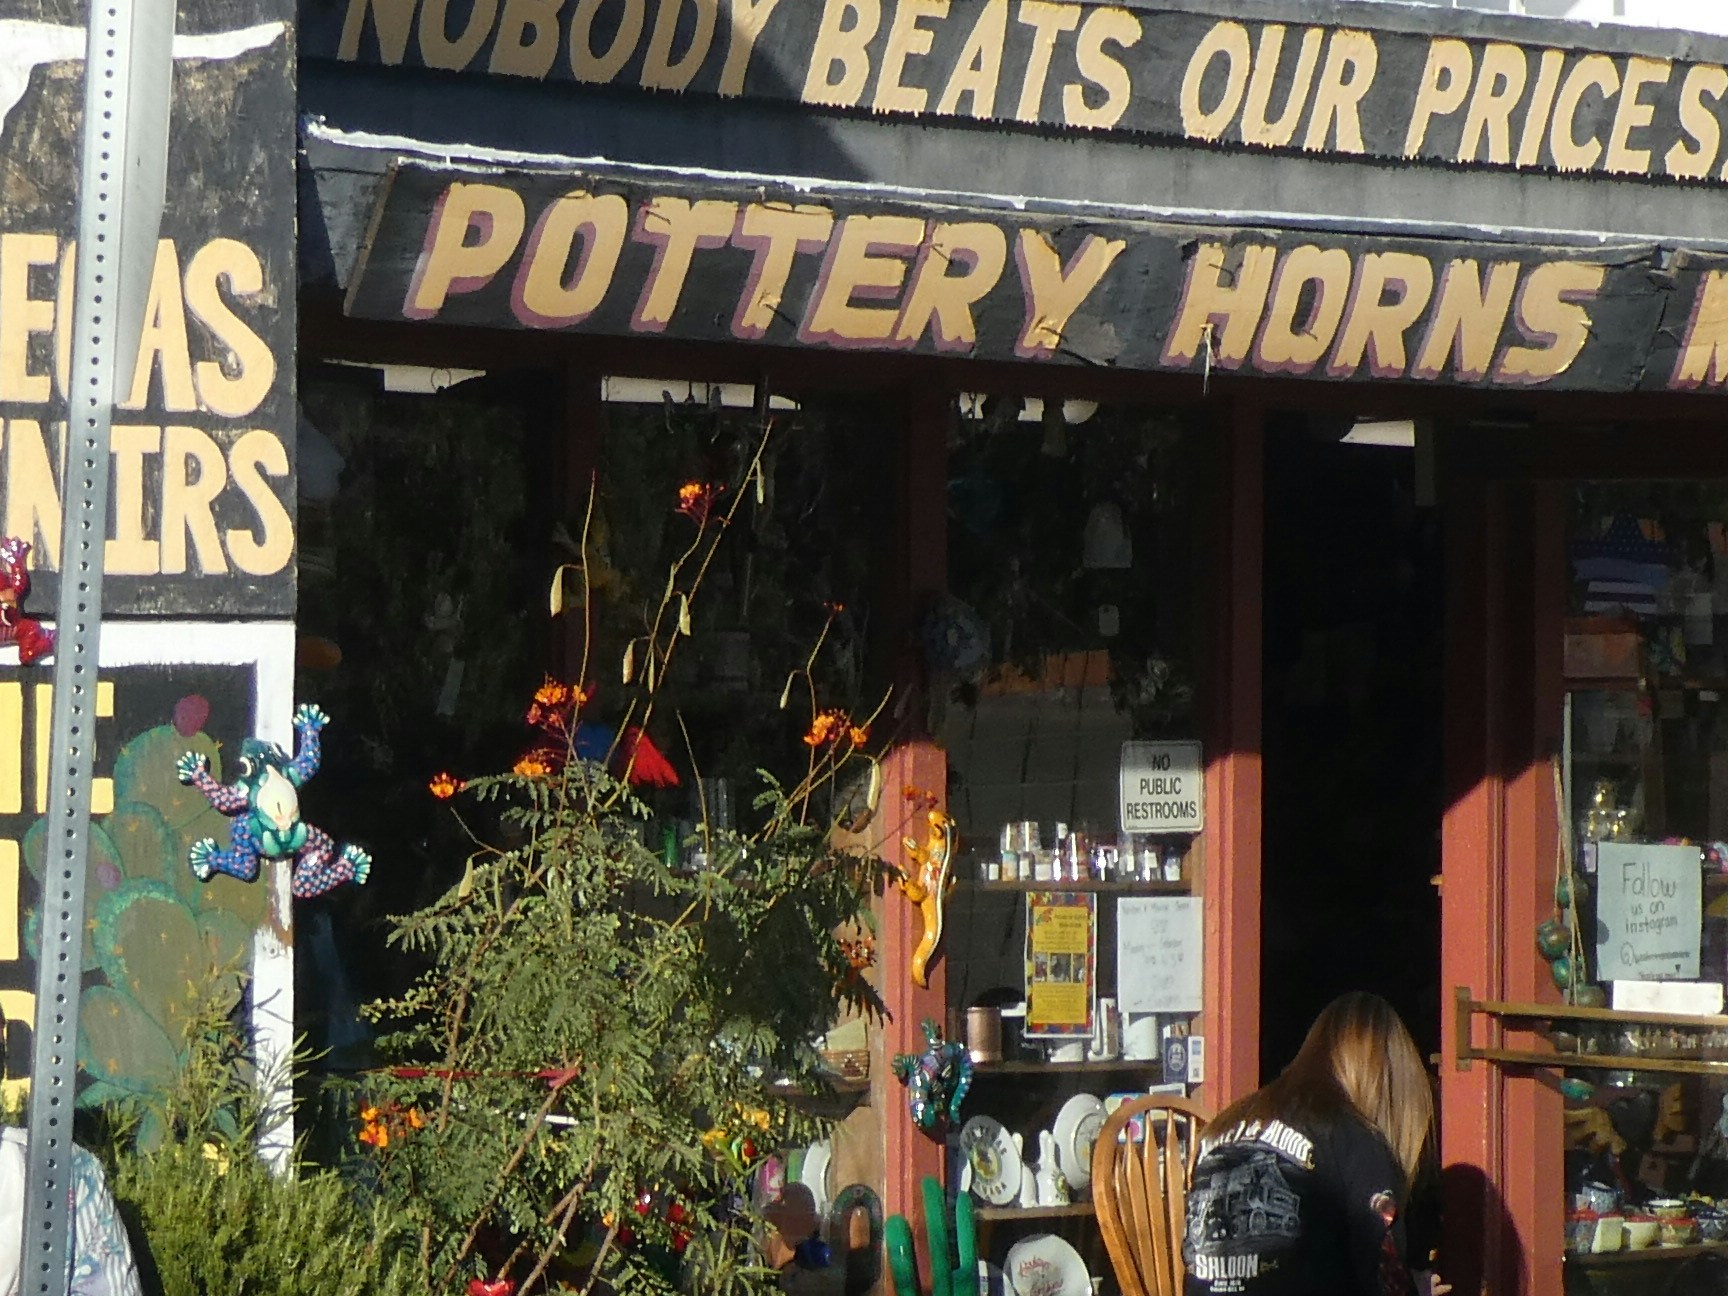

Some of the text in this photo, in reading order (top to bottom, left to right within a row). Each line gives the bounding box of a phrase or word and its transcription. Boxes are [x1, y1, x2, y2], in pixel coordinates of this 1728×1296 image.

[1179, 18, 1379, 155] OUR
[402, 179, 1128, 360] POTTERY
[1159, 238, 1608, 386] HORNS
[1152, 753, 1171, 771] NO
[1139, 776, 1182, 796] PUBLIC
[1126, 800, 1197, 820] RESTROOMS
[1623, 862, 1677, 899] Follow
[1631, 903, 1644, 916] us
[1195, 1253, 1259, 1280] SALOON
